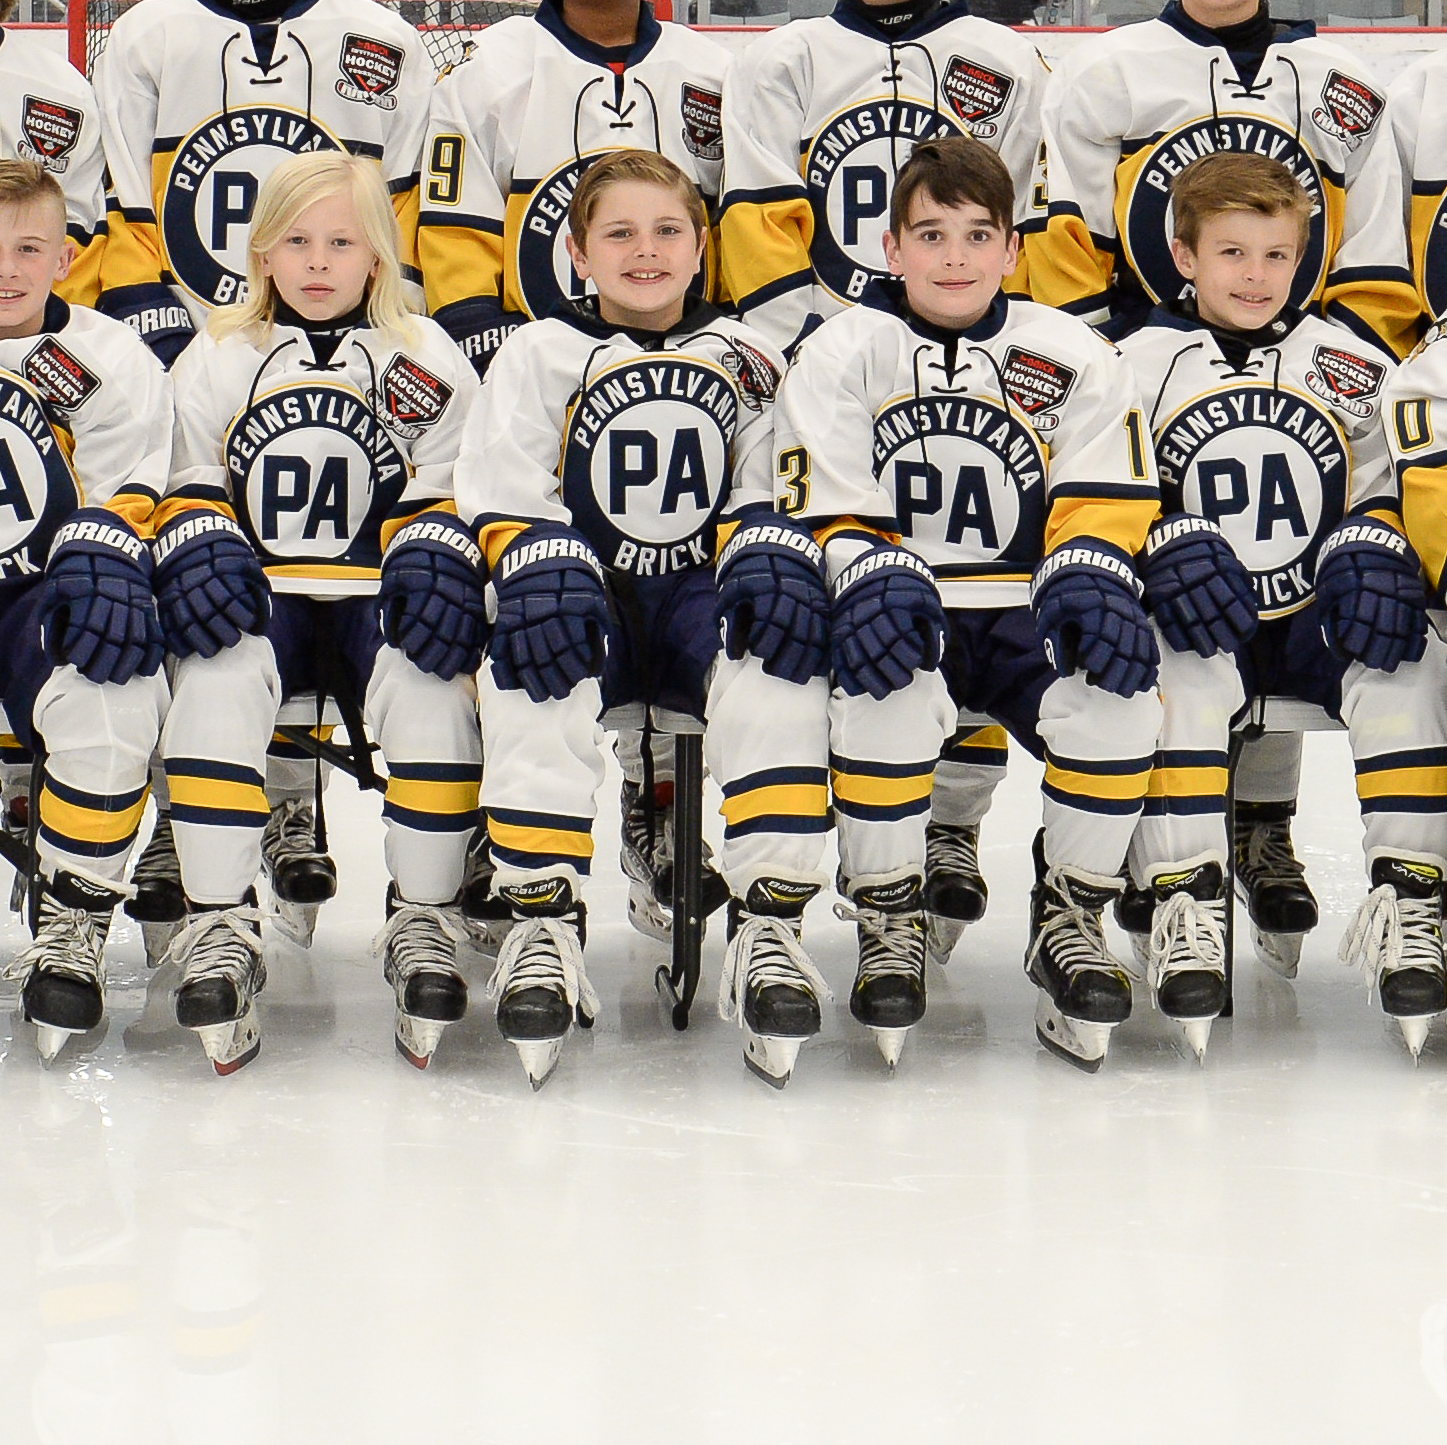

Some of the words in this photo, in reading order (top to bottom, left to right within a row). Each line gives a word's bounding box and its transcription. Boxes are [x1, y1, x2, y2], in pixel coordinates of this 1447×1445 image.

[344, 54, 397, 79] HOCKEY
[683, 105, 720, 125] HOCKE
[946, 76, 1003, 106] HOCKEY
[1326, 87, 1373, 123] HOCKEY
[25, 115, 76, 140] HOCKEY
[426, 133, 466, 206] 9
[29, 354, 82, 402] HOCKEY
[386, 368, 441, 414] HOCKEY
[1003, 367, 1065, 396] HOCKEY
[1317, 355, 1377, 388] HOCKEY
[574, 366, 736, 449] PENNSYLVANIA
[1393, 398, 1435, 453] 0
[229, 393, 401, 483] PENNSYLVANIA
[874, 402, 1041, 493] ENNSYLVANIA
[1123, 408, 1150, 481] 1
[1158, 394, 1342, 485] PENNSYLVANIA
[609, 427, 711, 515] PA
[777, 445, 813, 517] 3
[262, 454, 349, 541] PA
[894, 459, 1000, 550] PA
[1196, 452, 1309, 542] PA
[614, 534, 709, 576] BRICK
[1255, 562, 1312, 606] ICK
[509, 879, 558, 895] BAUER
[767, 880, 815, 894] BAUER
